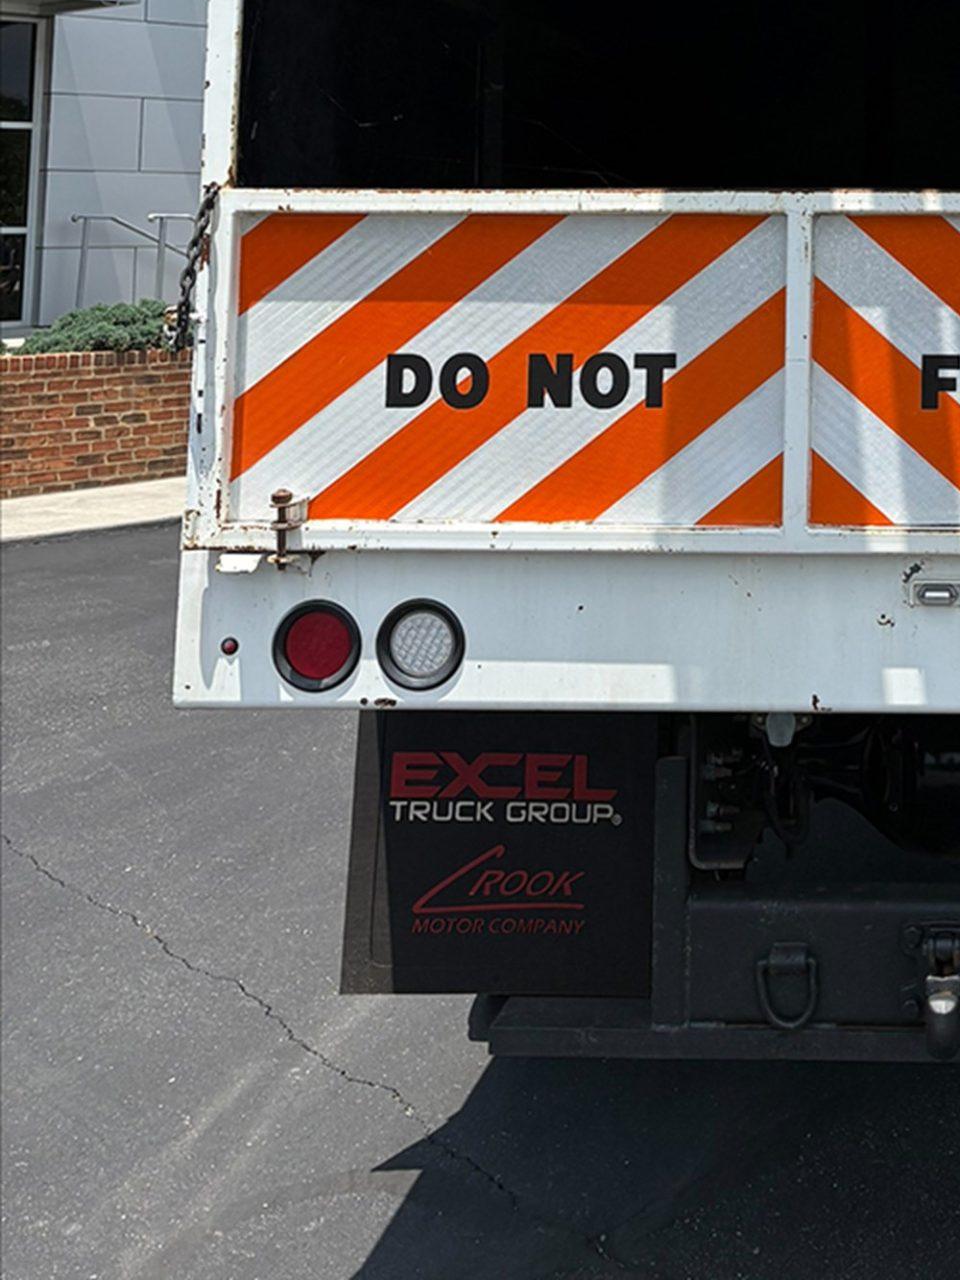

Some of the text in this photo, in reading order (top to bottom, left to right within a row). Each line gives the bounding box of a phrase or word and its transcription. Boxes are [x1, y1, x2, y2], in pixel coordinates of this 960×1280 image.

[385, 352, 490, 410] DO
[527, 352, 677, 410] NOT
[389, 751, 618, 801] EXCEL
[389, 801, 494, 822] TRUCK
[411, 918, 586, 935] MOTOR COMPANY
